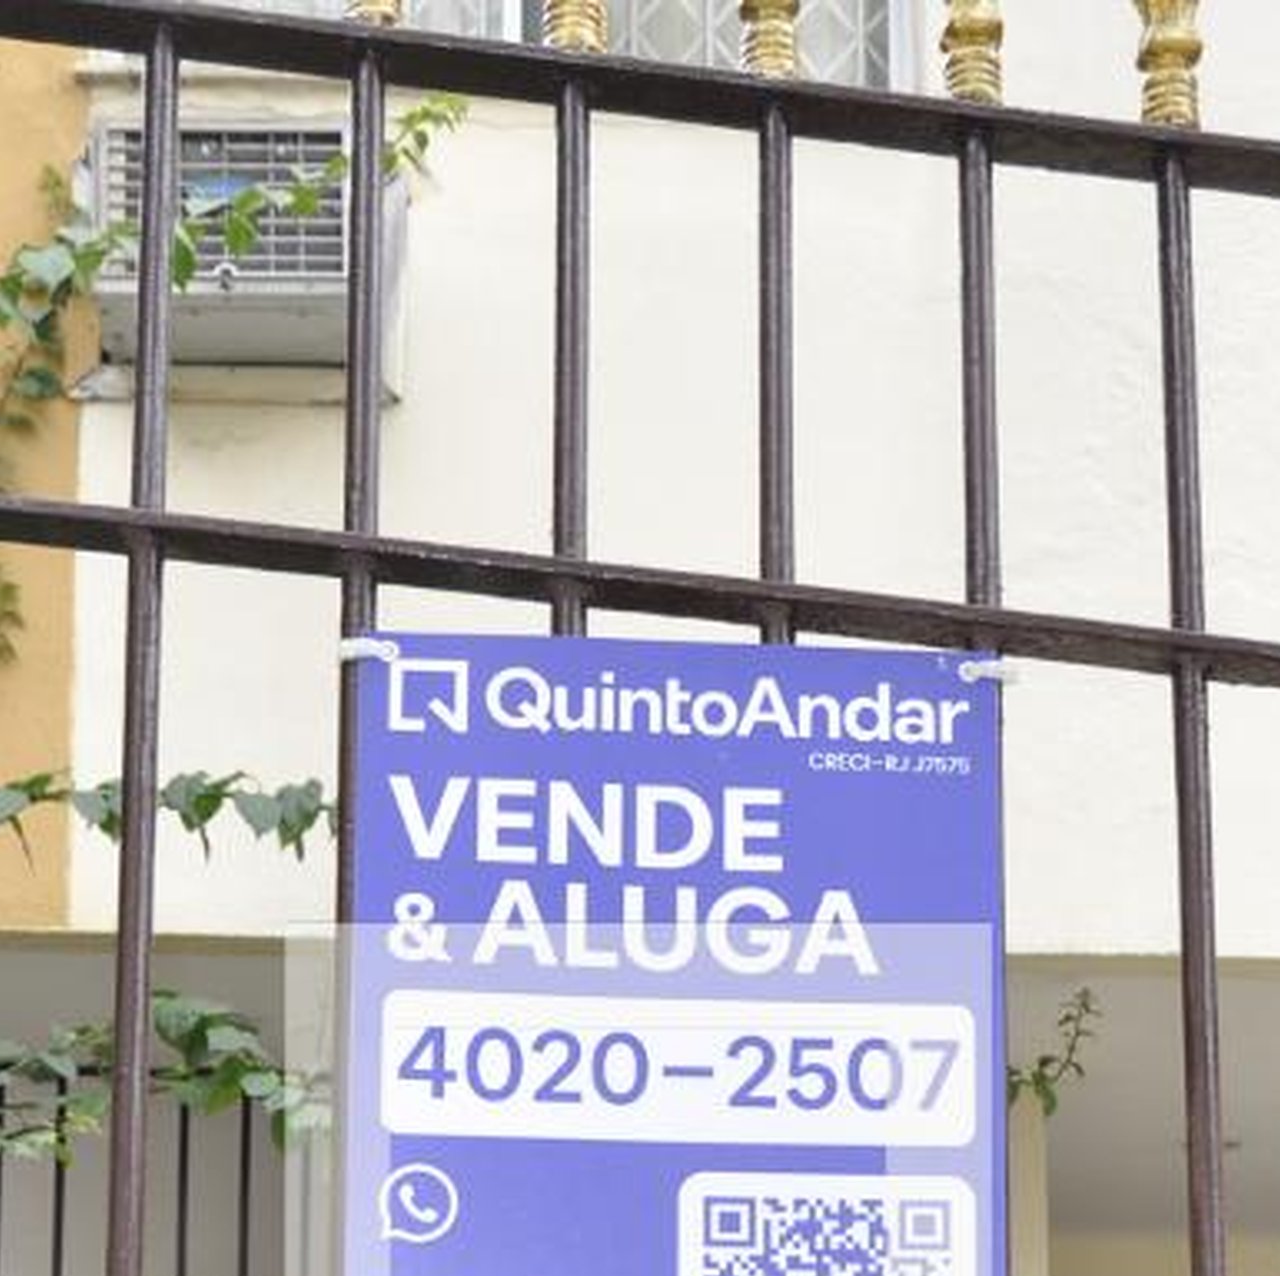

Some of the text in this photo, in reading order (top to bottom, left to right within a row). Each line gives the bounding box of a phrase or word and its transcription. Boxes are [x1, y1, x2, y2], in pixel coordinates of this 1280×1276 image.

[486, 666, 969, 744] QuintoAndar
[388, 775, 784, 871] VENDE
[387, 879, 880, 976] & ALUGA
[397, 1025, 961, 1112] 4020-2507
